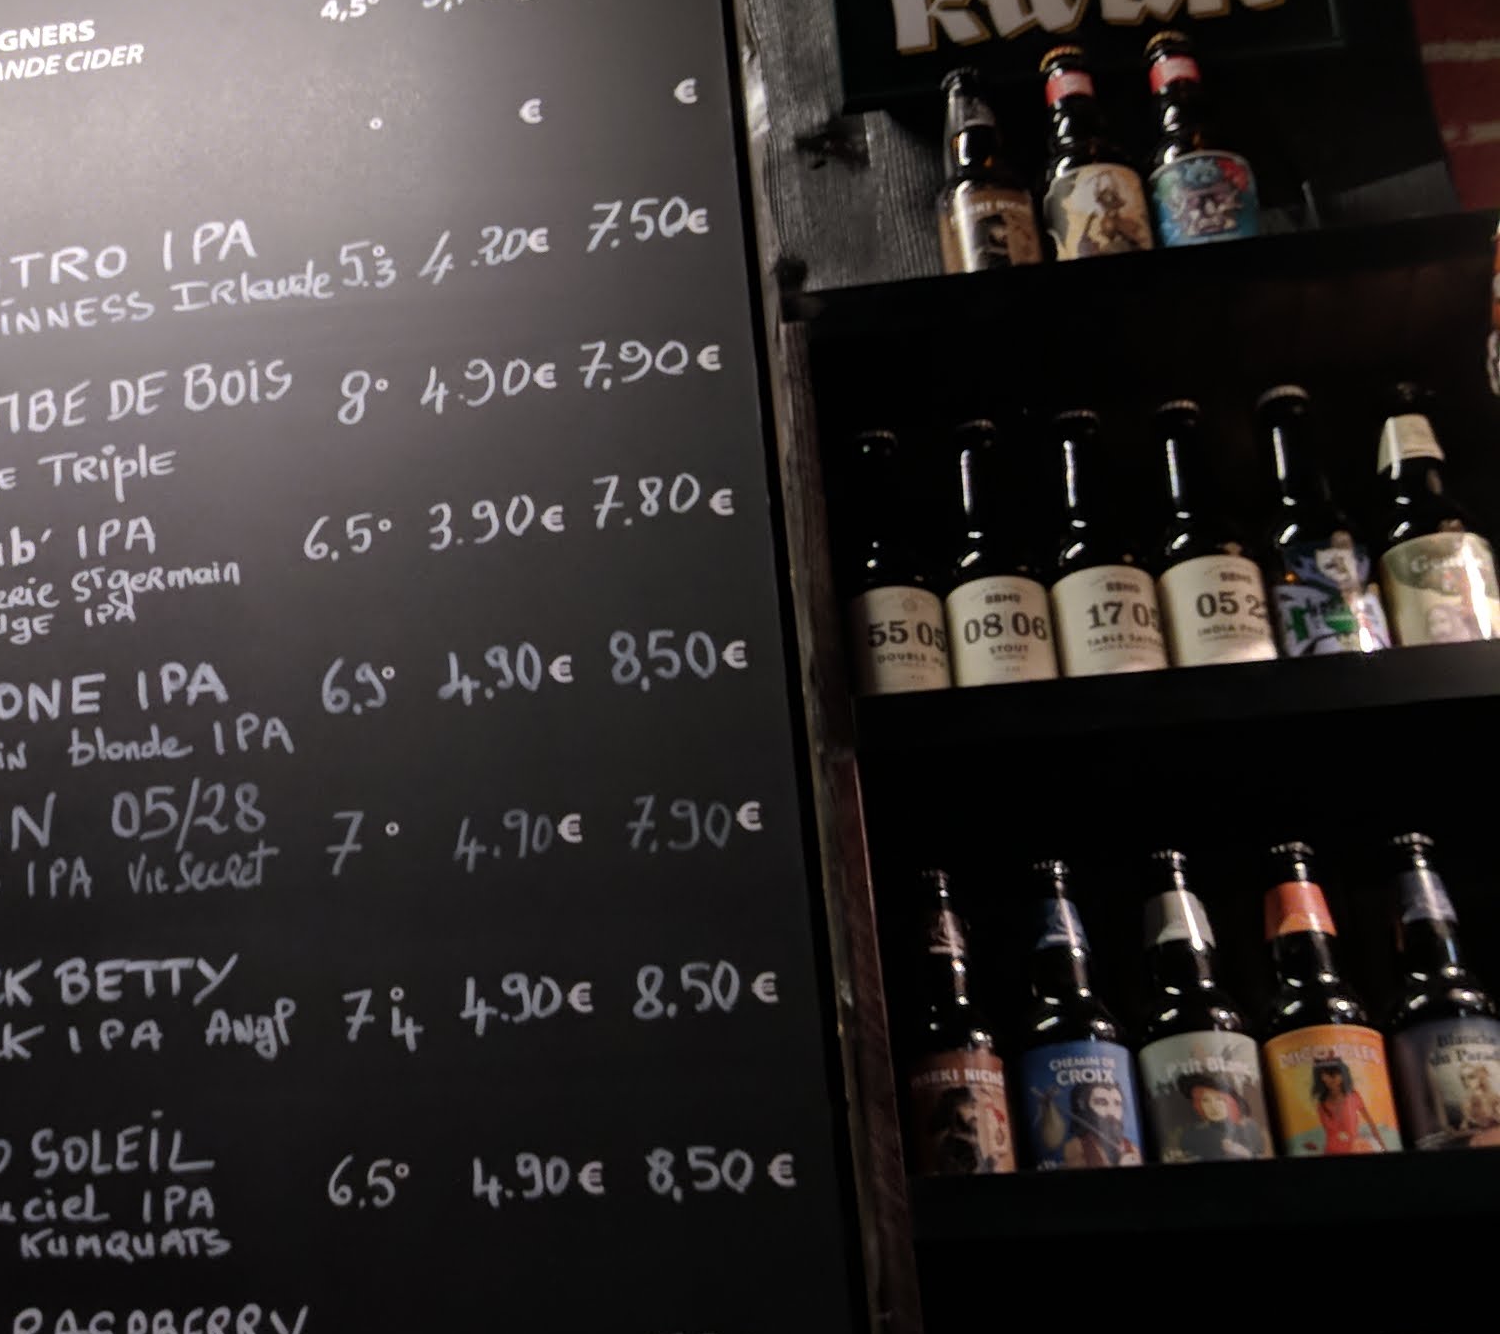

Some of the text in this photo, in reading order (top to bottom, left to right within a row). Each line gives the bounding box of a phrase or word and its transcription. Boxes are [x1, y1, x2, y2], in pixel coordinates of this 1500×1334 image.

[64, 42, 146, 74] CIDER
[76, 514, 156, 560] IPA
[1088, 602, 1123, 630] 17
[1197, 592, 1237, 618] 05
[868, 620, 908, 649] 55
[964, 612, 1047, 644] 08 06
[136, 661, 229, 711] IPA
[110, 776, 267, 853] 05/28
[53, 952, 239, 1007] BETTY
[1055, 1068, 1115, 1086] CROIX
